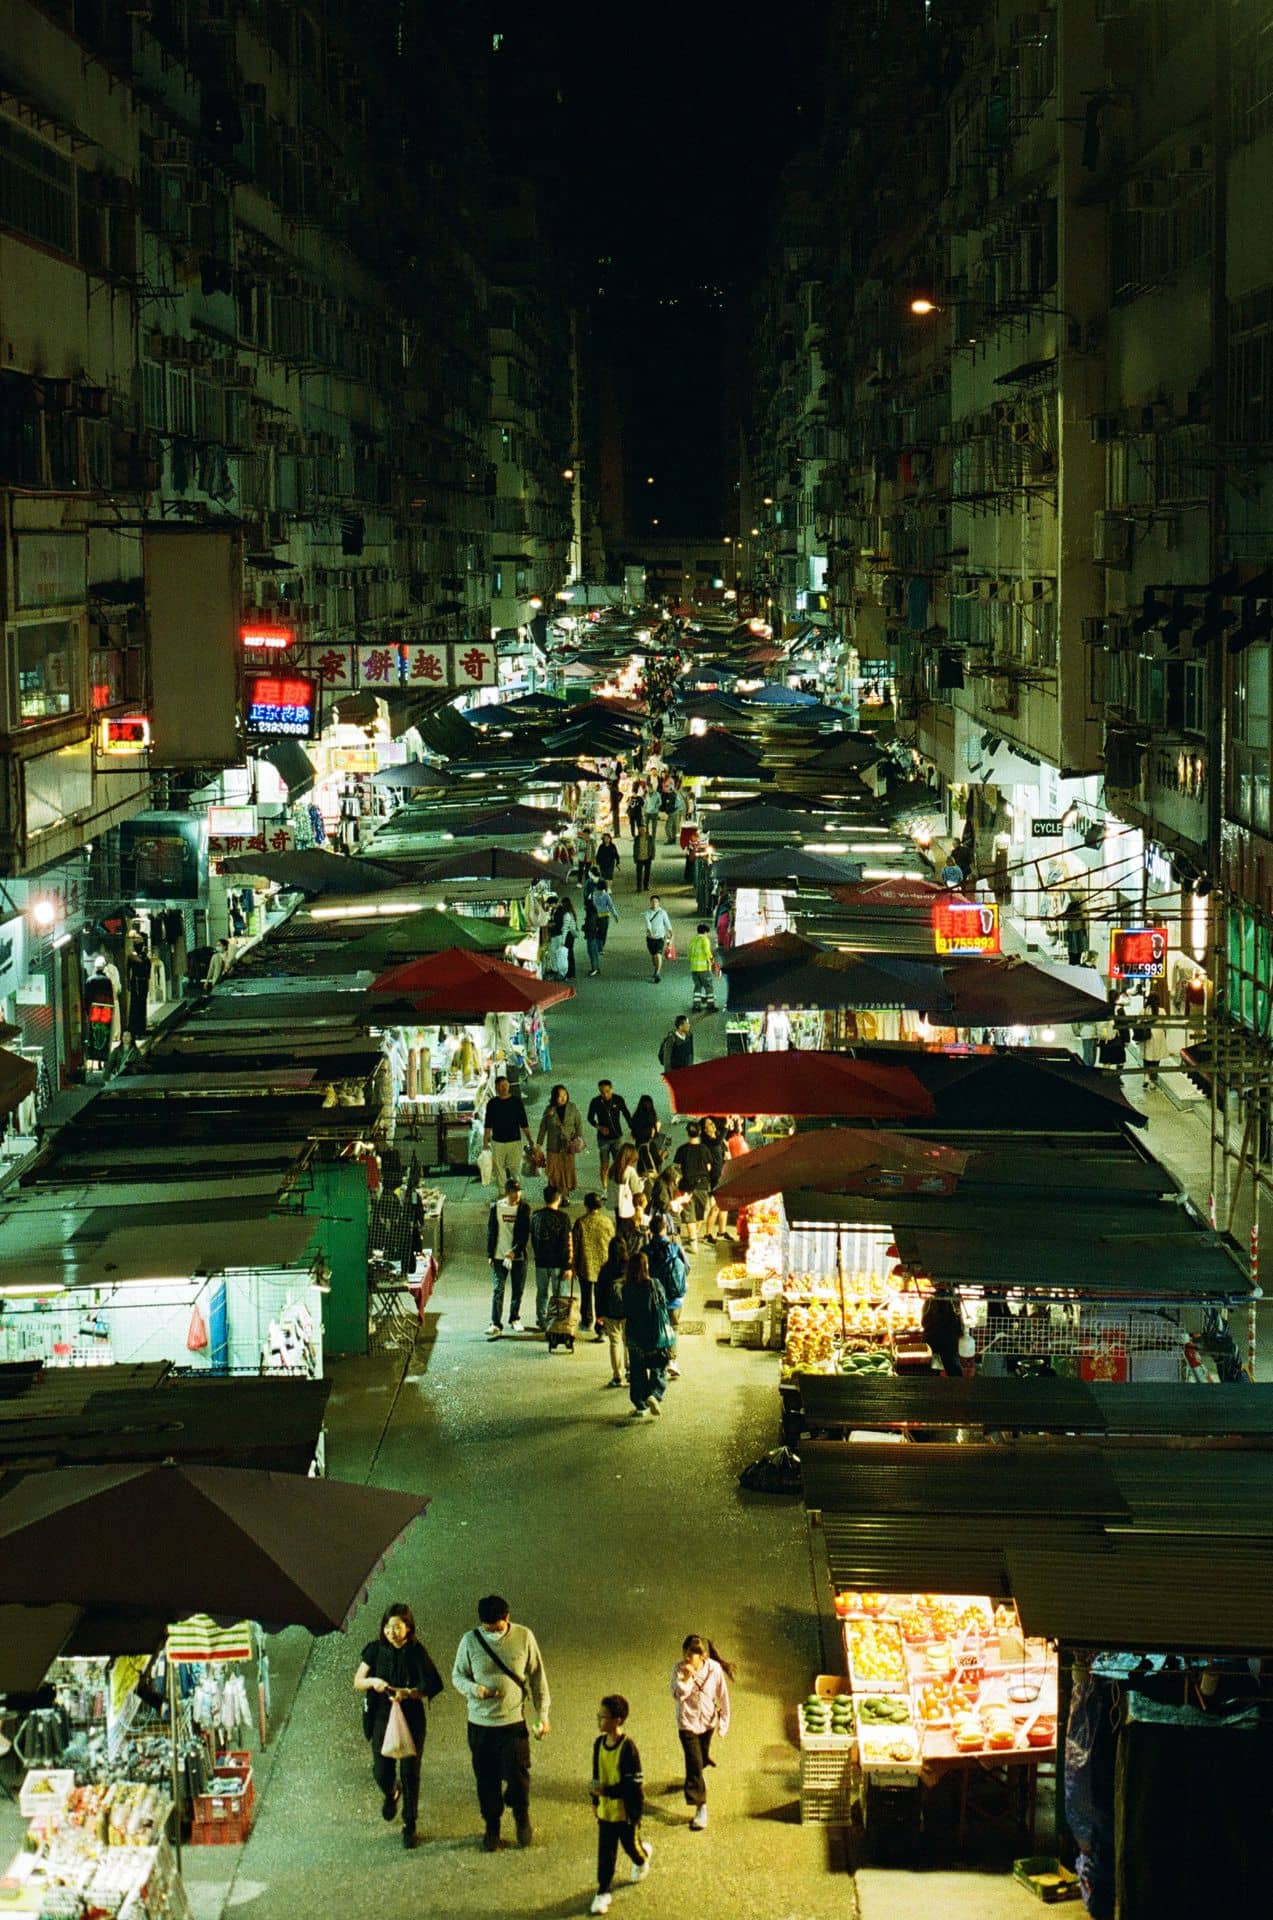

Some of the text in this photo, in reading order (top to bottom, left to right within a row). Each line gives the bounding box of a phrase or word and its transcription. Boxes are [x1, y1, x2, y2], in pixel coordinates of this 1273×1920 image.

[1033, 822, 1063, 834] CYCLE
[938, 936, 995, 951] 91755993
[1113, 962, 1164, 976] 91755993
